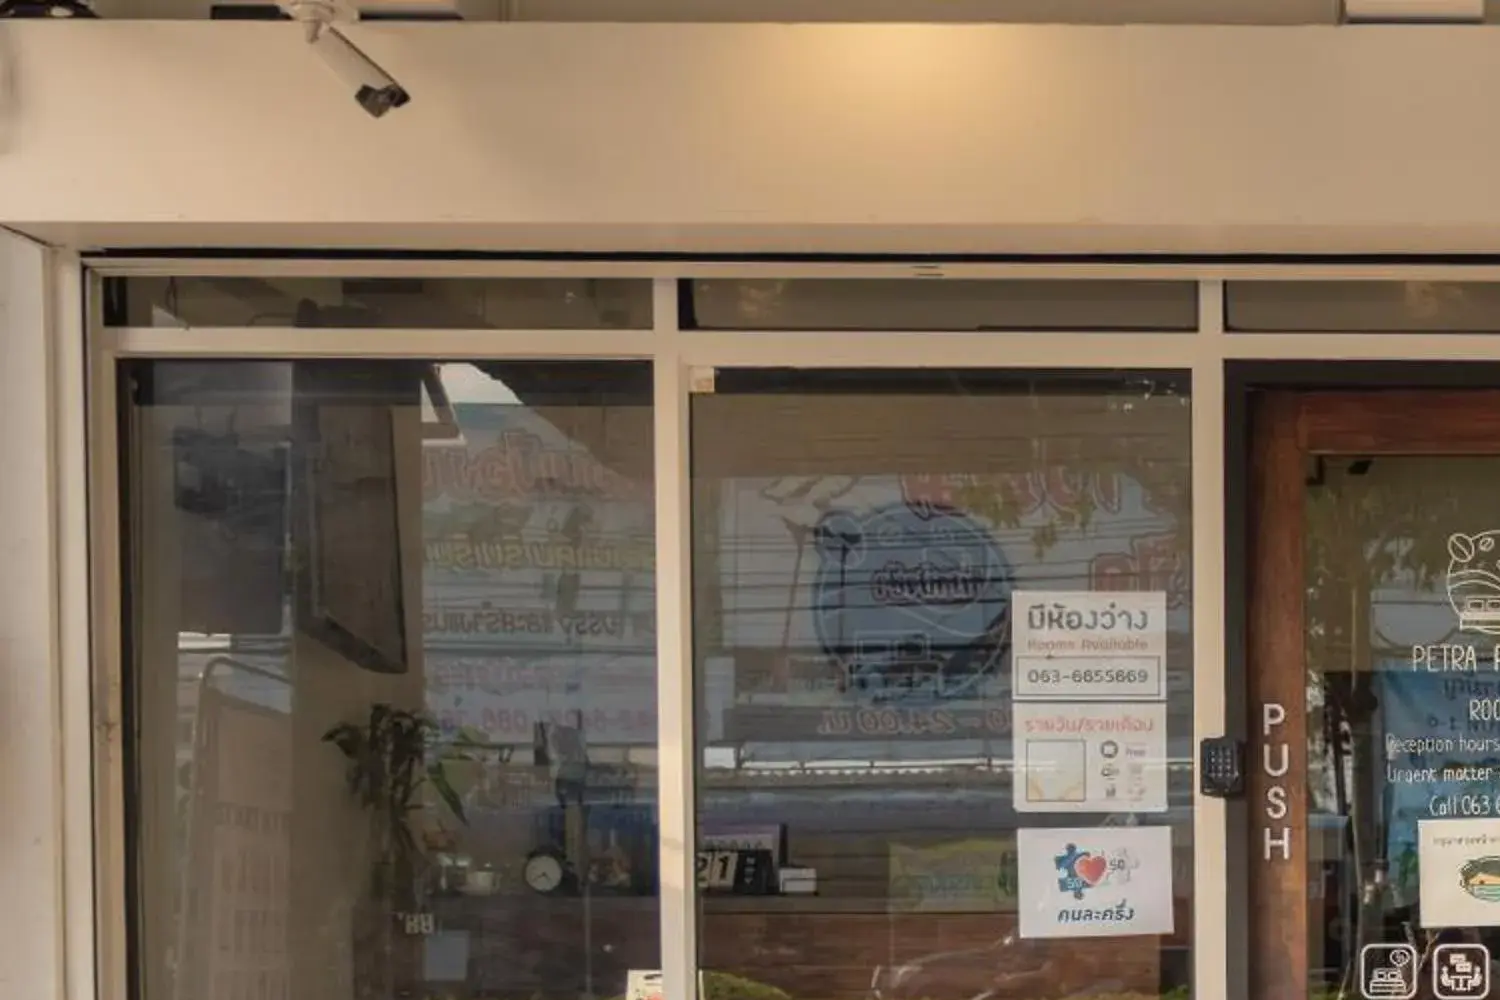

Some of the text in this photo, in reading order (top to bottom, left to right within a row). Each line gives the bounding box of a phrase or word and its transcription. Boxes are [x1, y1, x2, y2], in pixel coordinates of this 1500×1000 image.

[1027, 602, 1149, 631] มีห้องว่าง
[1412, 645, 1478, 672] PETRA
[1386, 733, 1454, 756] Reception
[1262, 702, 1291, 861] PUSH
[1387, 761, 1437, 785] Urgent
[1443, 767, 1493, 782] matter
[1429, 795, 1457, 816] Call
[1461, 795, 1491, 815] 063
[1057, 898, 1135, 922] คนละครึ่ง
